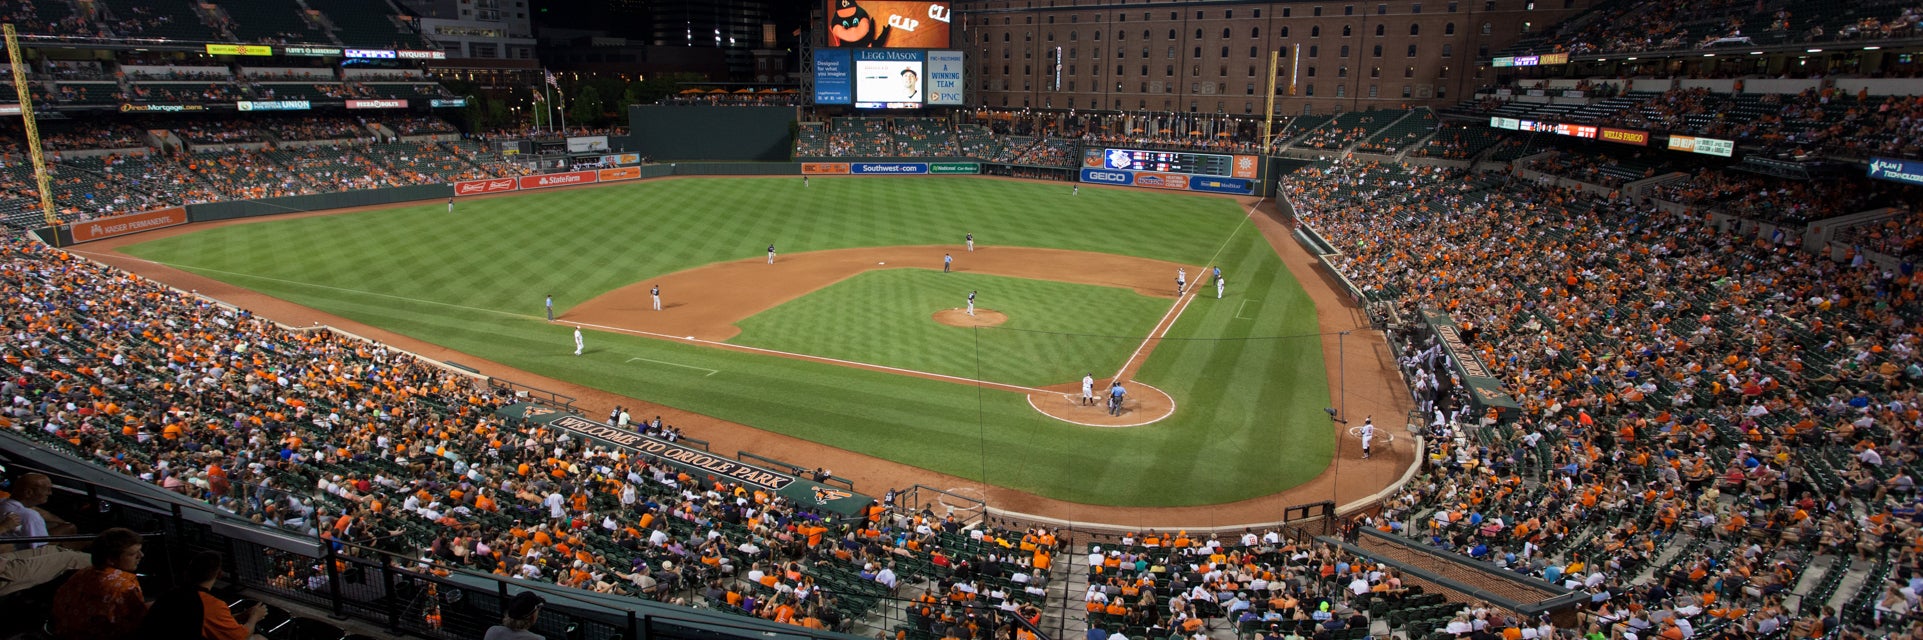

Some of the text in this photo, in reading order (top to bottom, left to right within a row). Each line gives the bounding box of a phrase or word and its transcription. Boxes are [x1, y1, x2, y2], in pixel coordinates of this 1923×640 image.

[888, 14, 919, 32] CLAP
[862, 51, 916, 60] LEGG MASON
[281, 100, 310, 109] UNION
[1603, 130, 1622, 140] WELLS
[1623, 133, 1643, 142] FARGO
[1880, 162, 1897, 170] PLAN
[1089, 171, 1126, 182] GEICO
[104, 224, 128, 233] KAISER
[558, 417, 789, 488] WELCOME TO ORIOLE PARK
